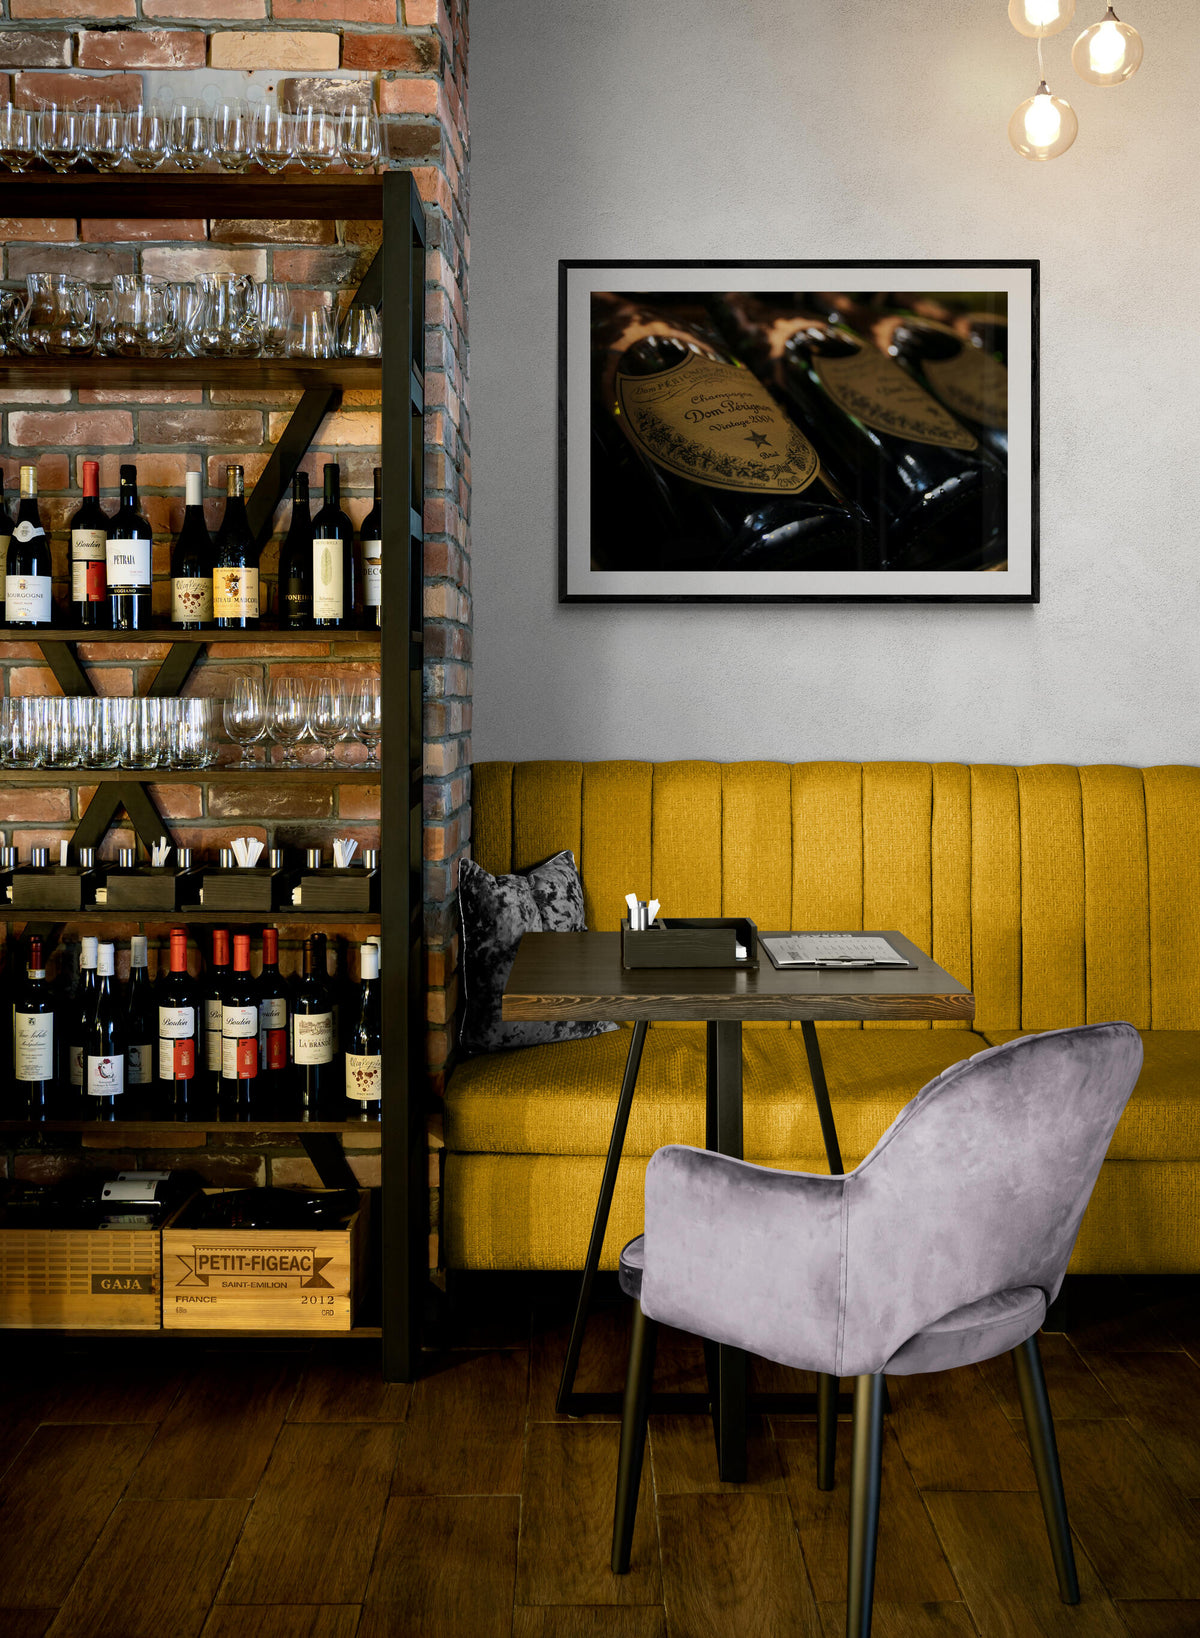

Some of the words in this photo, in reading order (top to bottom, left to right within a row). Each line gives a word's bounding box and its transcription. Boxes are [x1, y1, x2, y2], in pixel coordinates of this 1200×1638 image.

[684, 409, 725, 423] Dom
[720, 399, 774, 415] Pérignon
[709, 419, 751, 432] Vintage
[363, 567, 382, 576] DEC
[199, 1255, 311, 1271] PETIT-FIGEAC
[100, 1279, 143, 1290] GAJA
[221, 1281, 288, 1289] SAINT-EMILION
[175, 1295, 217, 1303] FRANCE
[301, 1295, 335, 1305] 2012
